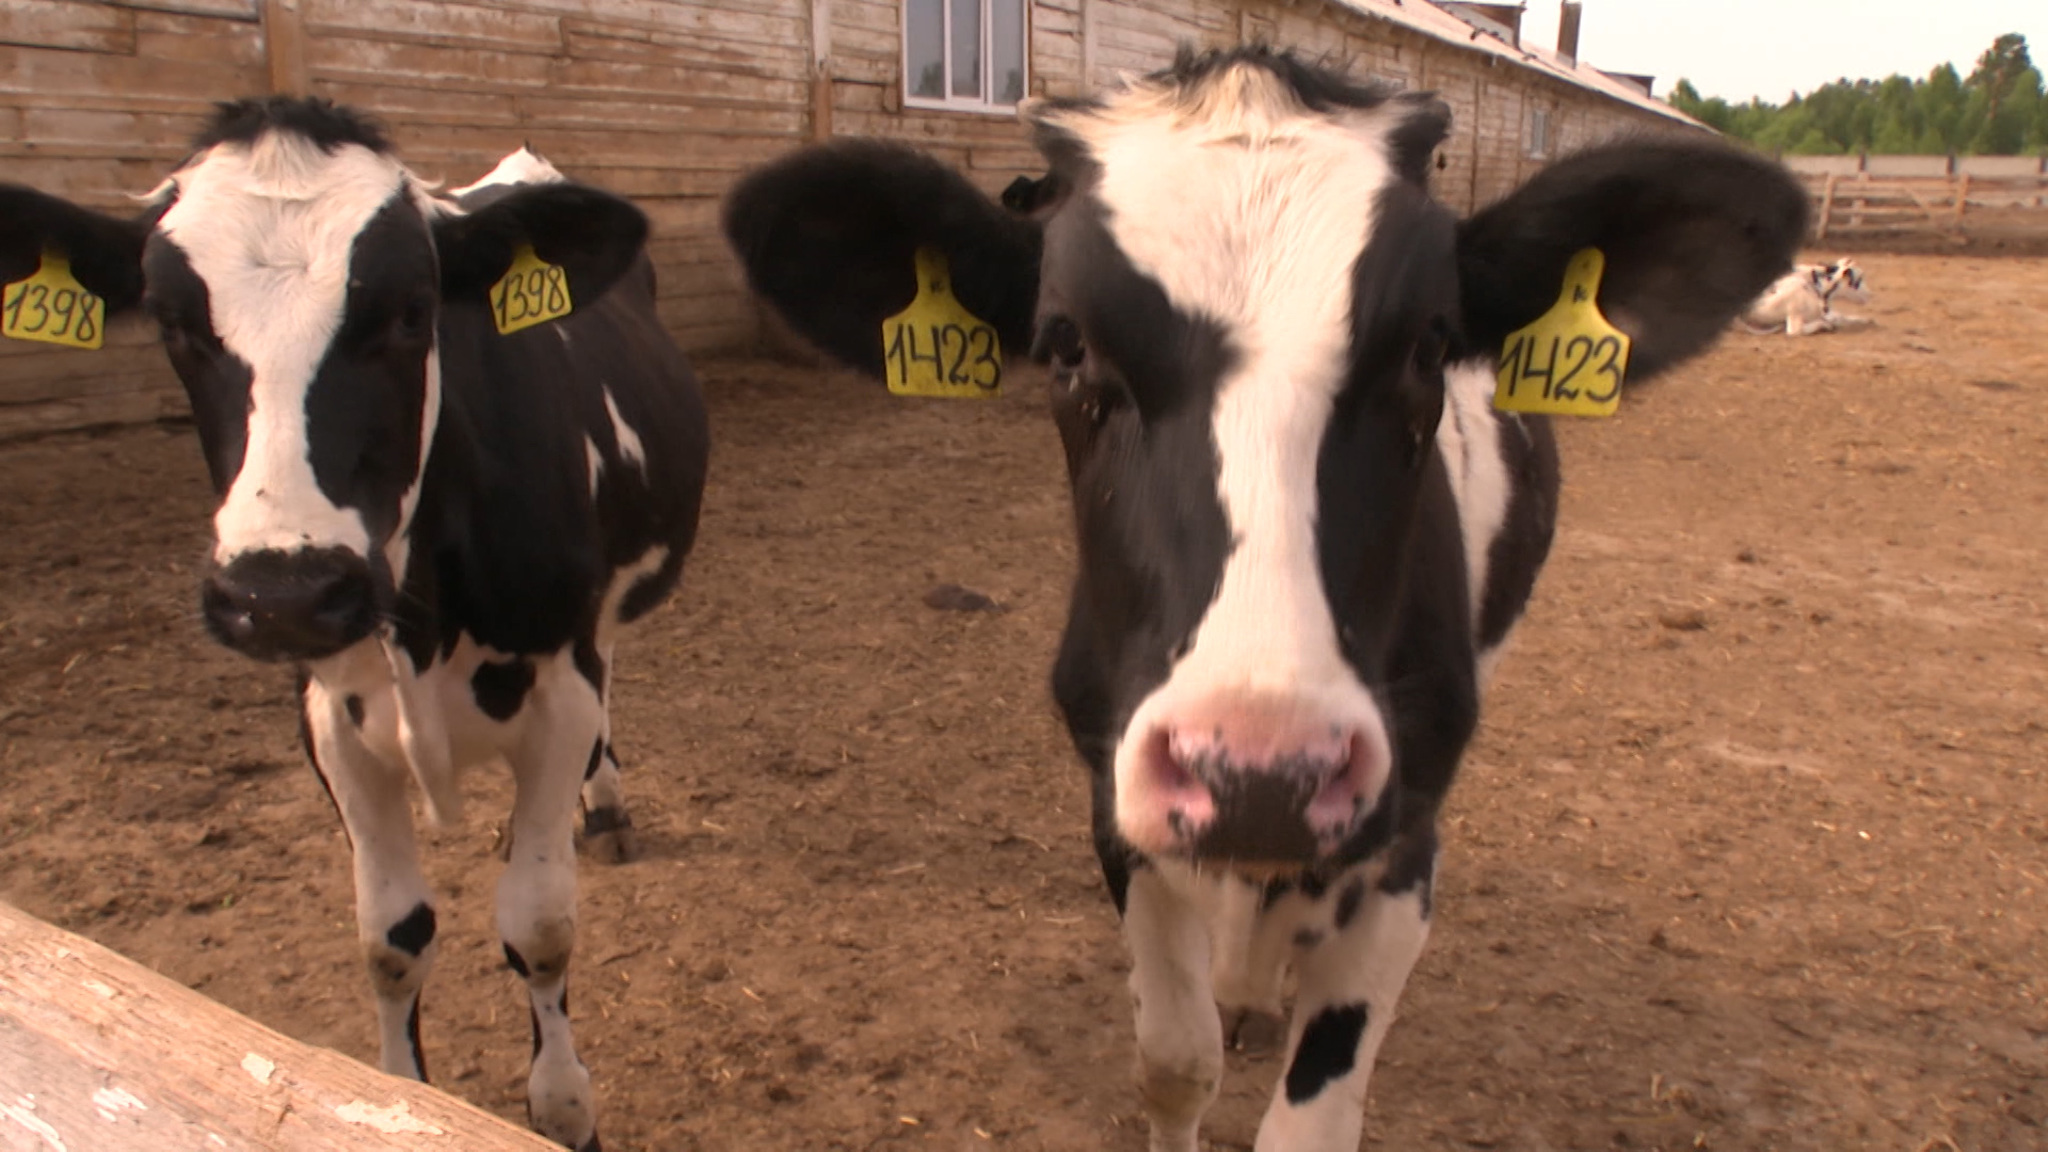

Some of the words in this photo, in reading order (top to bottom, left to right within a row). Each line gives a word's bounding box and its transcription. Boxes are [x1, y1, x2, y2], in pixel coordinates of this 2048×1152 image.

[5, 283, 97, 343] 1398
[496, 265, 566, 329] 1398
[887, 323, 1000, 391] 1423
[1500, 335, 1621, 404] 1423
